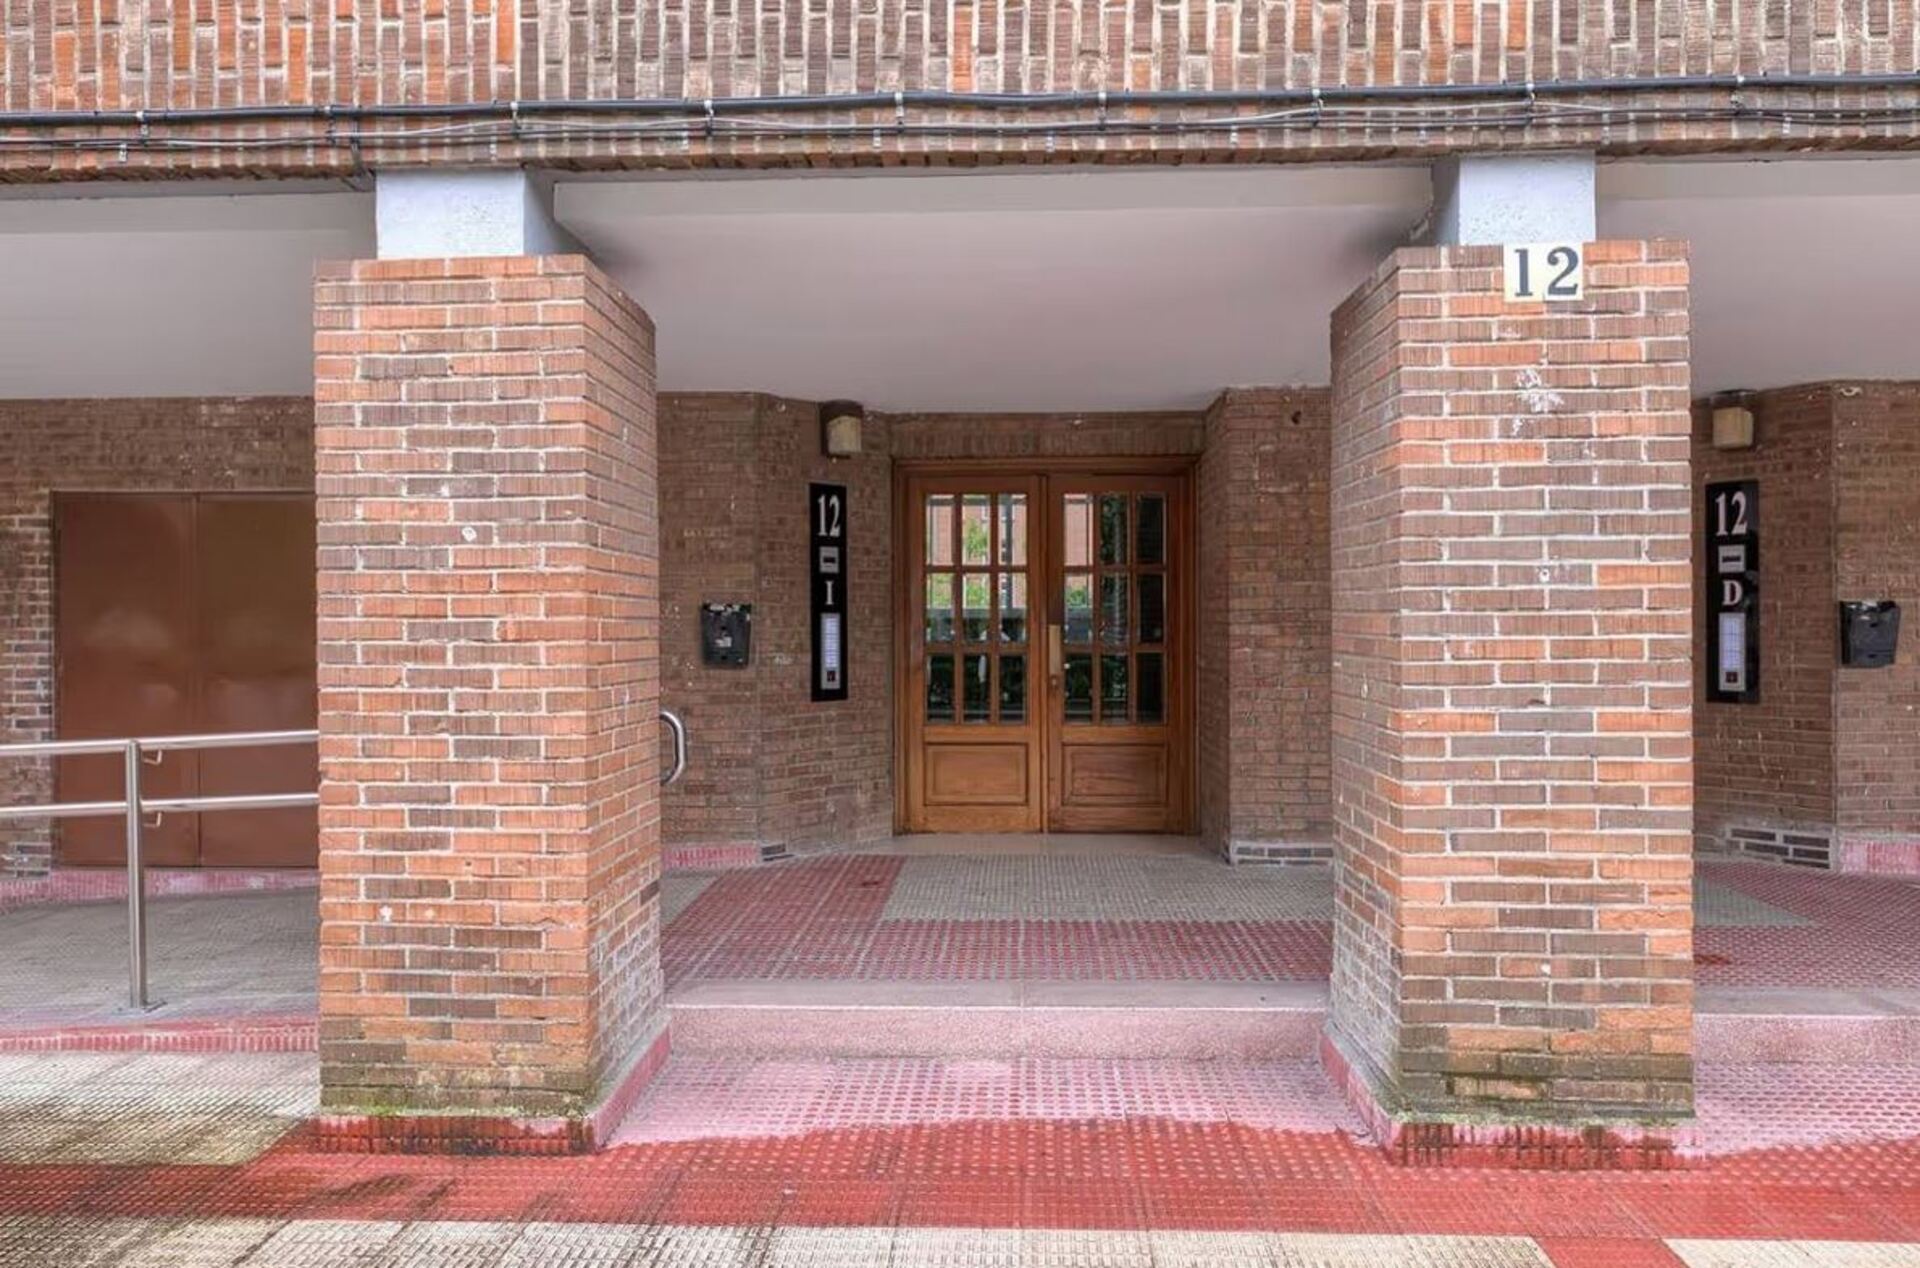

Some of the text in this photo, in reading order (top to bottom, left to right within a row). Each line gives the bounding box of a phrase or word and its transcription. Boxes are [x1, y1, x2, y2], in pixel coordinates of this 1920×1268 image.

[1514, 246, 1579, 297] 12
[818, 494, 841, 537] 12
[1715, 491, 1748, 536] 12
[1722, 580, 1743, 606] D
